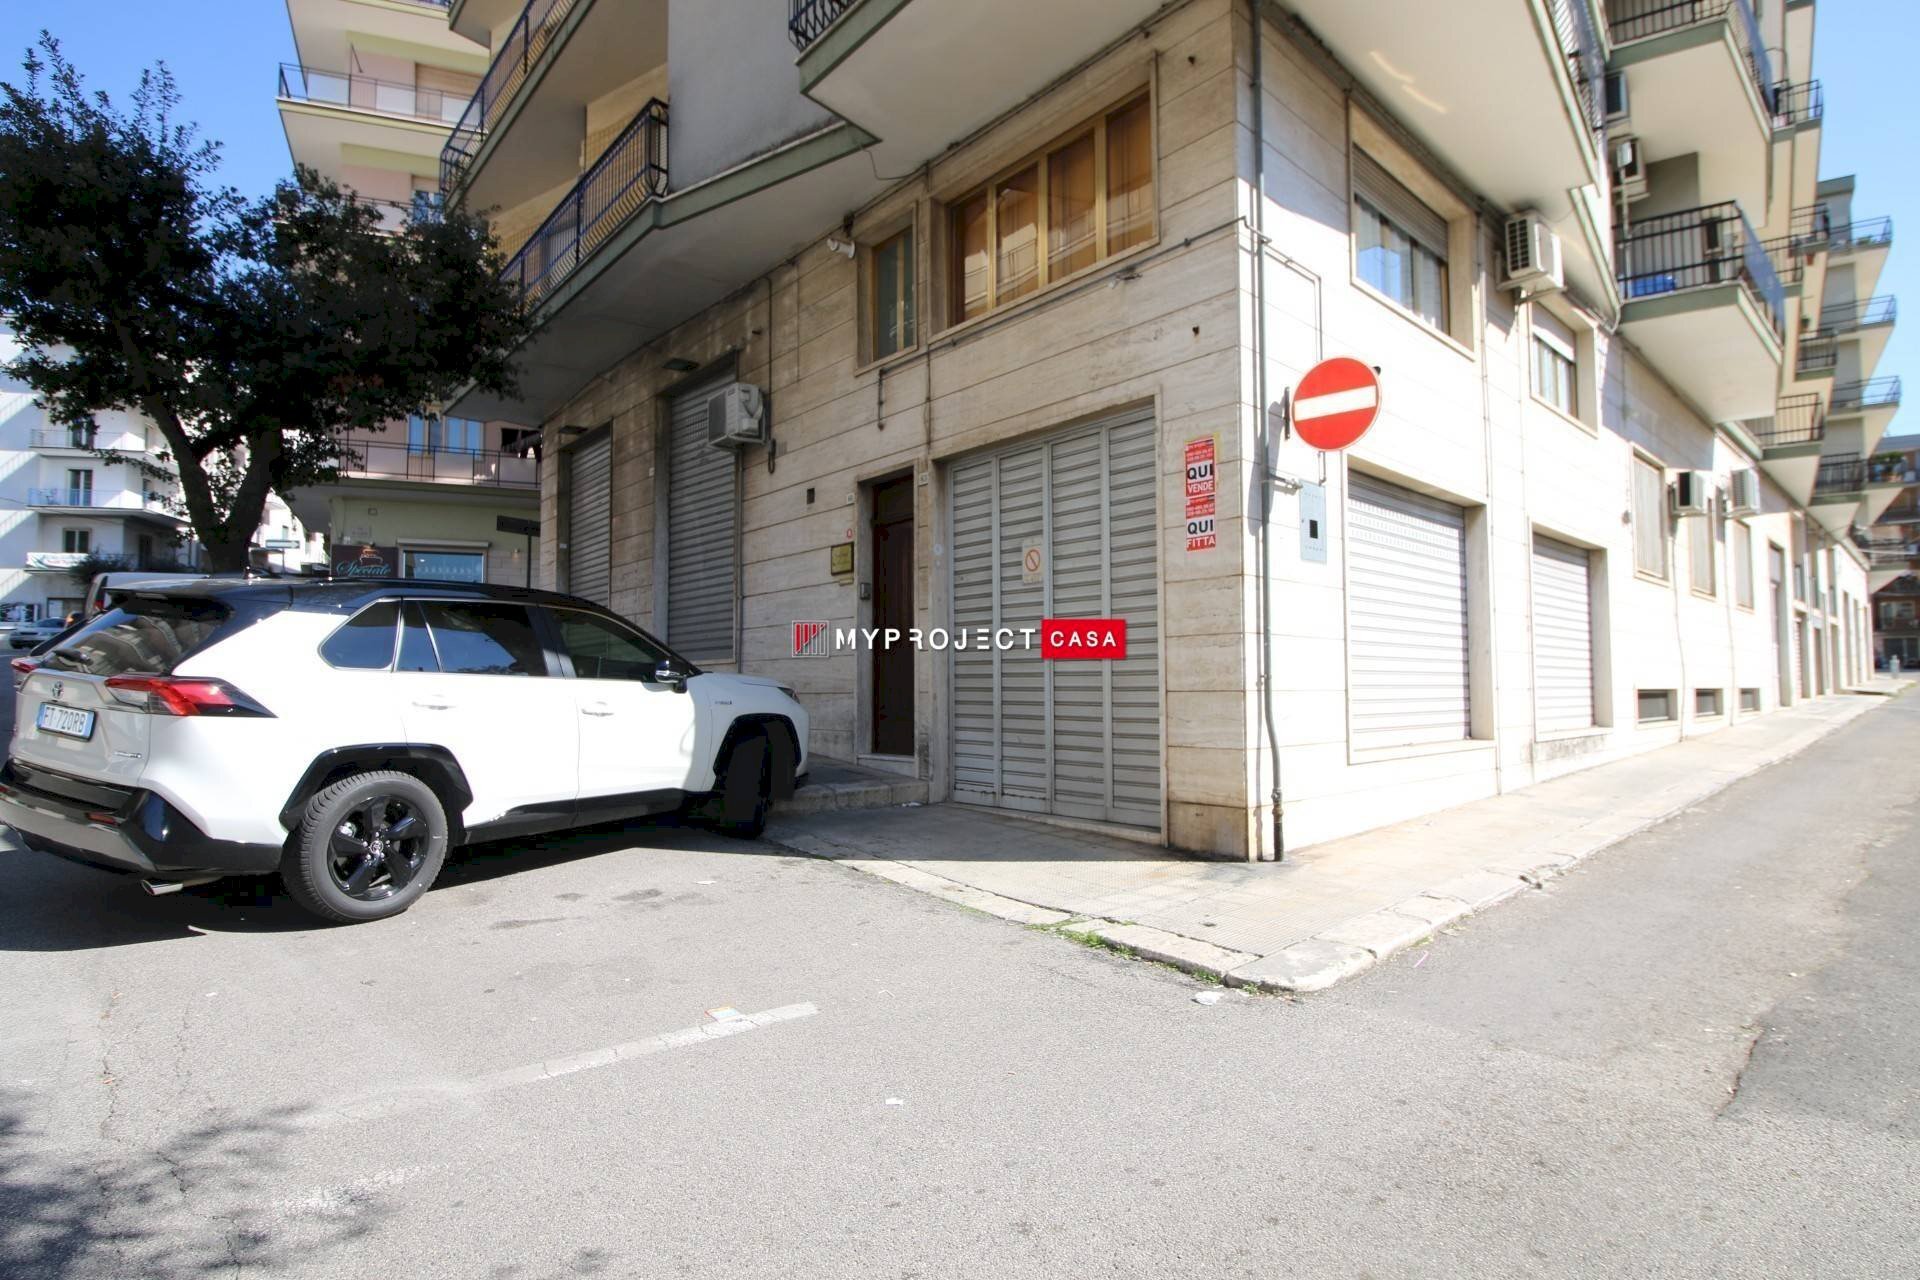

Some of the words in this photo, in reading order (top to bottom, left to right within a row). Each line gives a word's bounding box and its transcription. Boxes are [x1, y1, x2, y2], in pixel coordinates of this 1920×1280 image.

[1187, 464, 1214, 480] QUI
[1187, 481, 1214, 494] VENDE
[1187, 519, 1214, 535] QUI
[1187, 535, 1216, 549] FITTA
